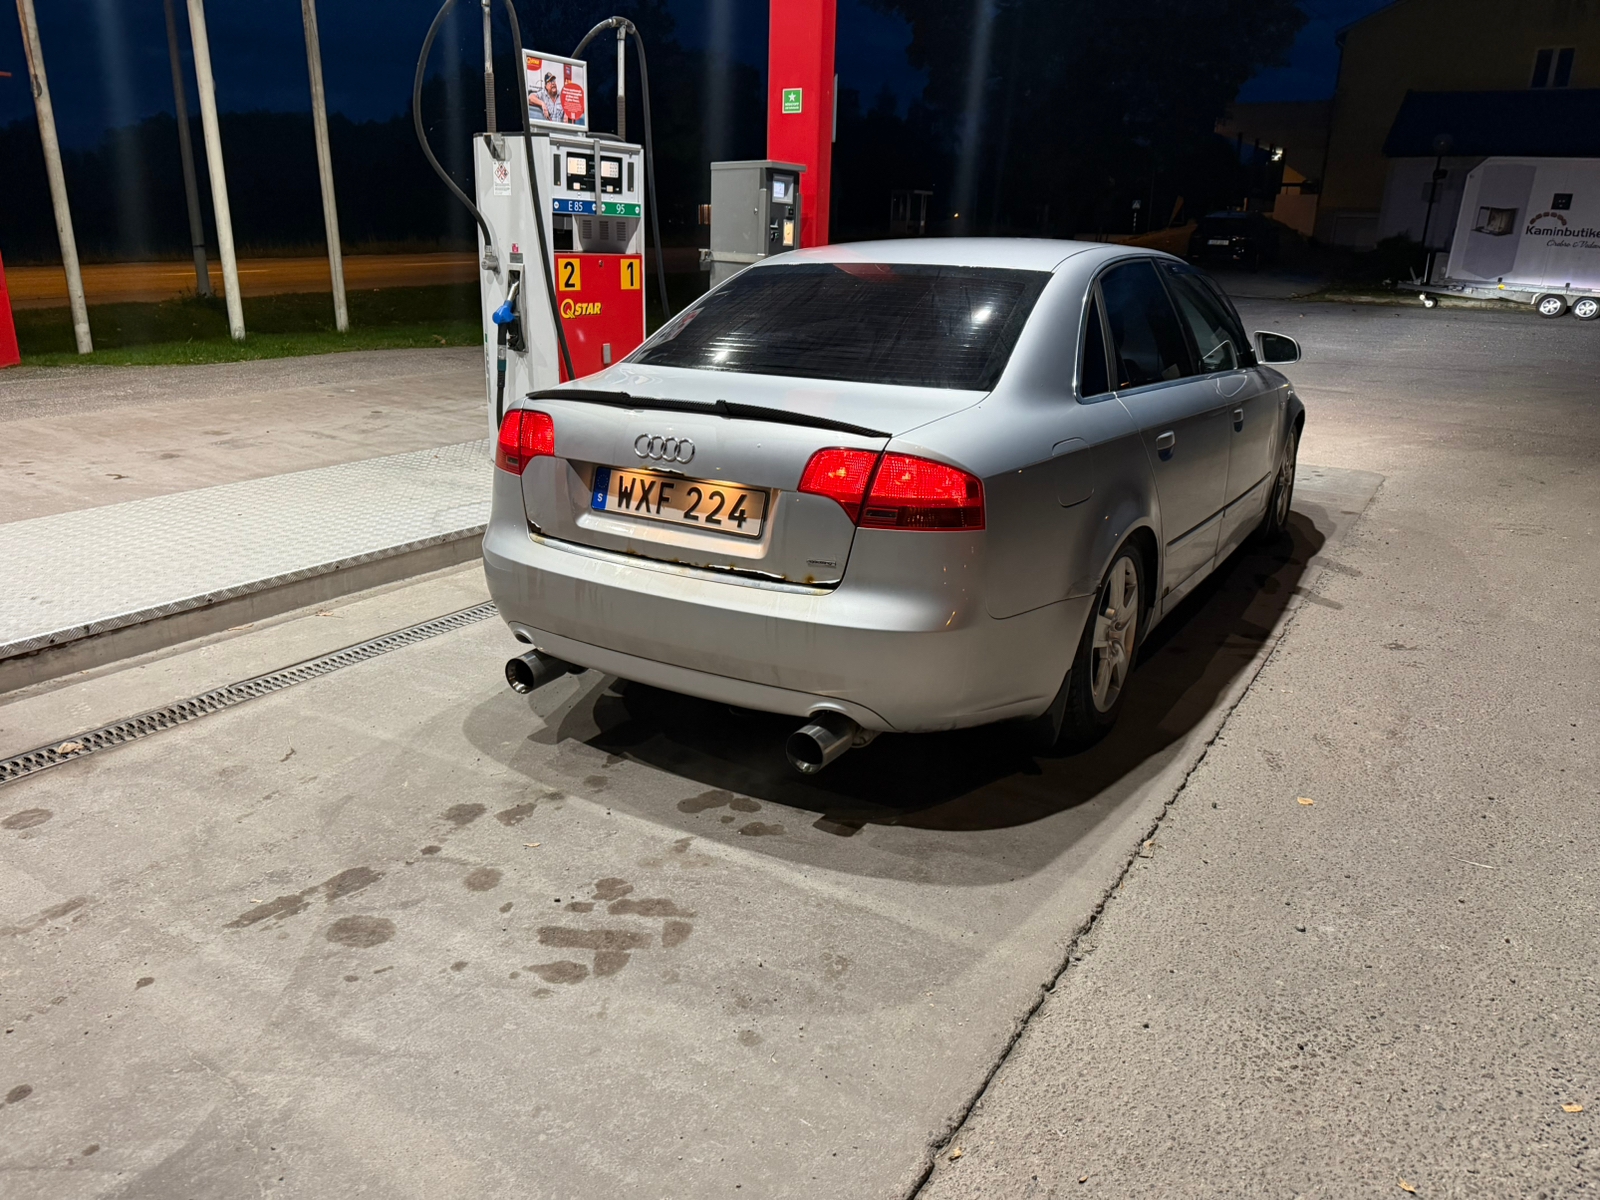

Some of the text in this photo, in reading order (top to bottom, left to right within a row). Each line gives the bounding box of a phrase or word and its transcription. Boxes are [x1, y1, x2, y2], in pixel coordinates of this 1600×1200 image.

[568, 201, 583, 212] E 85
[616, 204, 625, 214] 95
[1525, 225, 1600, 238] Kaminbutike
[563, 261, 576, 288] 2
[626, 261, 634, 287] 1
[560, 298, 602, 319] QSTAR
[597, 492, 603, 502] S
[617, 475, 748, 529] WXF 224
